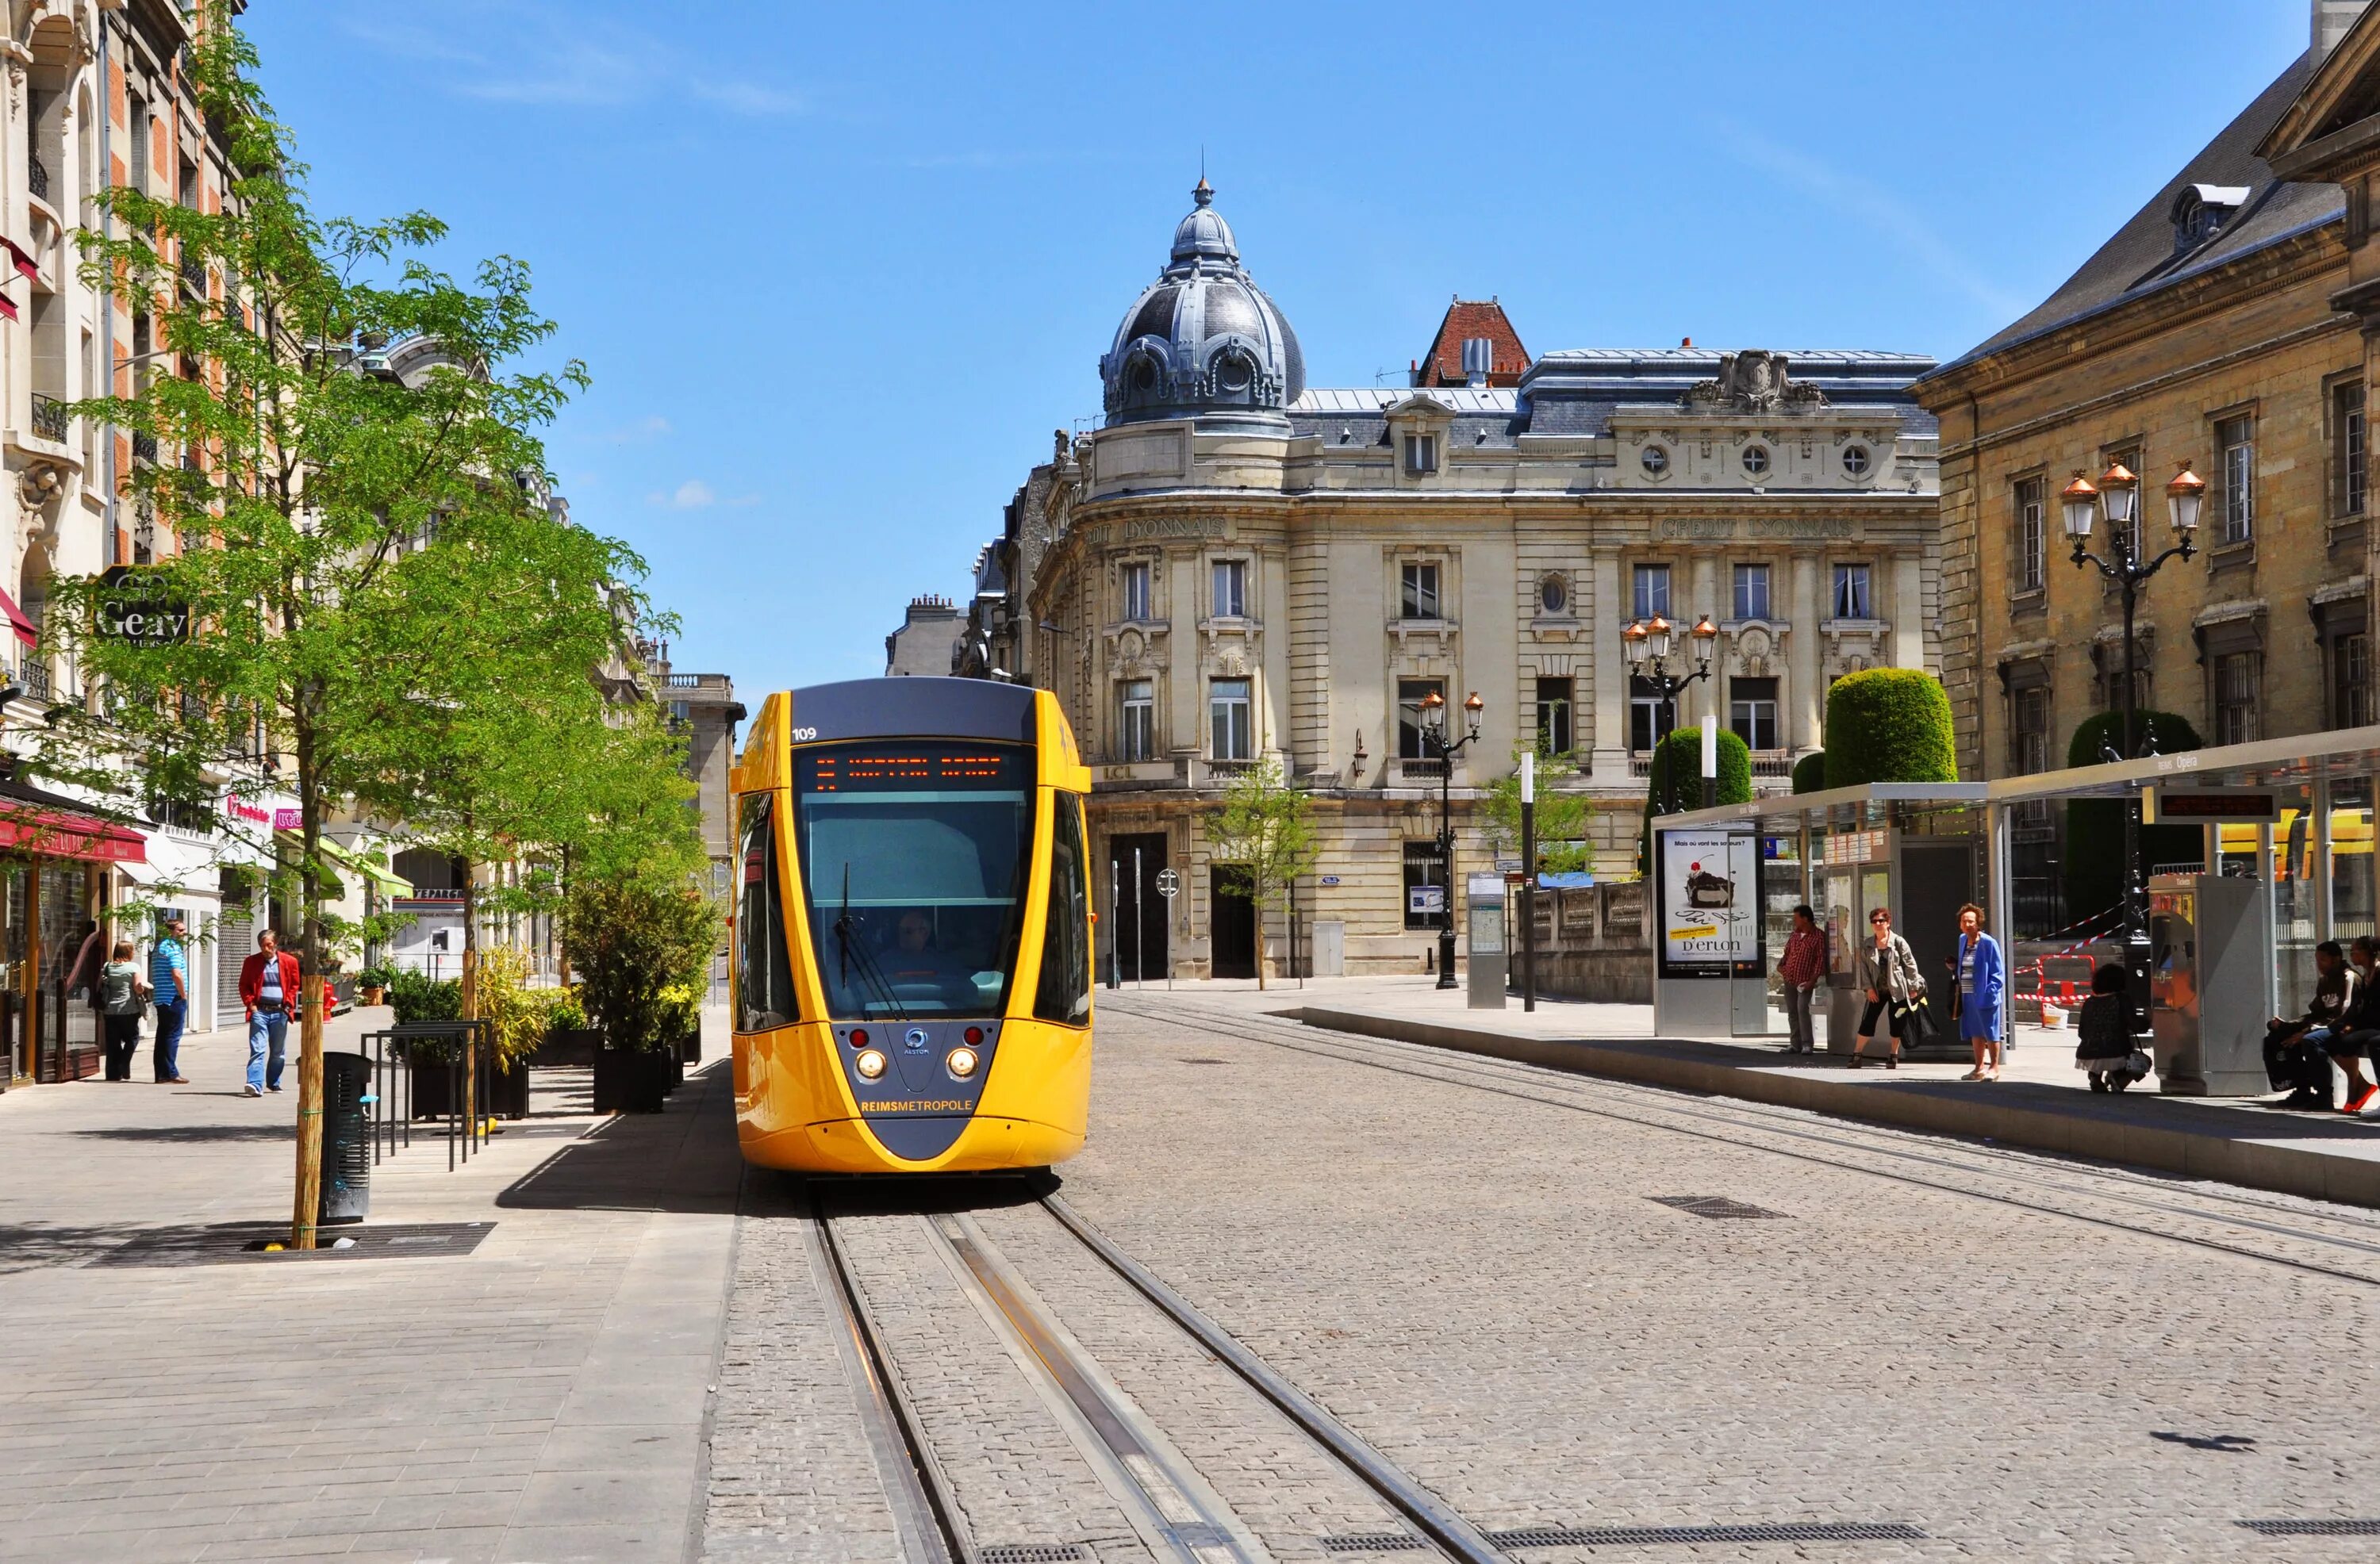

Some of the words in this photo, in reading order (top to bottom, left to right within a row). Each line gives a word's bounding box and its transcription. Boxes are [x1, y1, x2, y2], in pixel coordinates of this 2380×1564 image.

[1124, 518, 1224, 539] LYONNAIS
[1662, 519, 1737, 536] CREDIT
[1749, 519, 1853, 536] LYONNAIS
[97, 601, 186, 645] Geay
[792, 727, 816, 741] 109
[2176, 754, 2198, 771] Opéra
[861, 1100, 973, 1112] REIMSMETROPOLE
